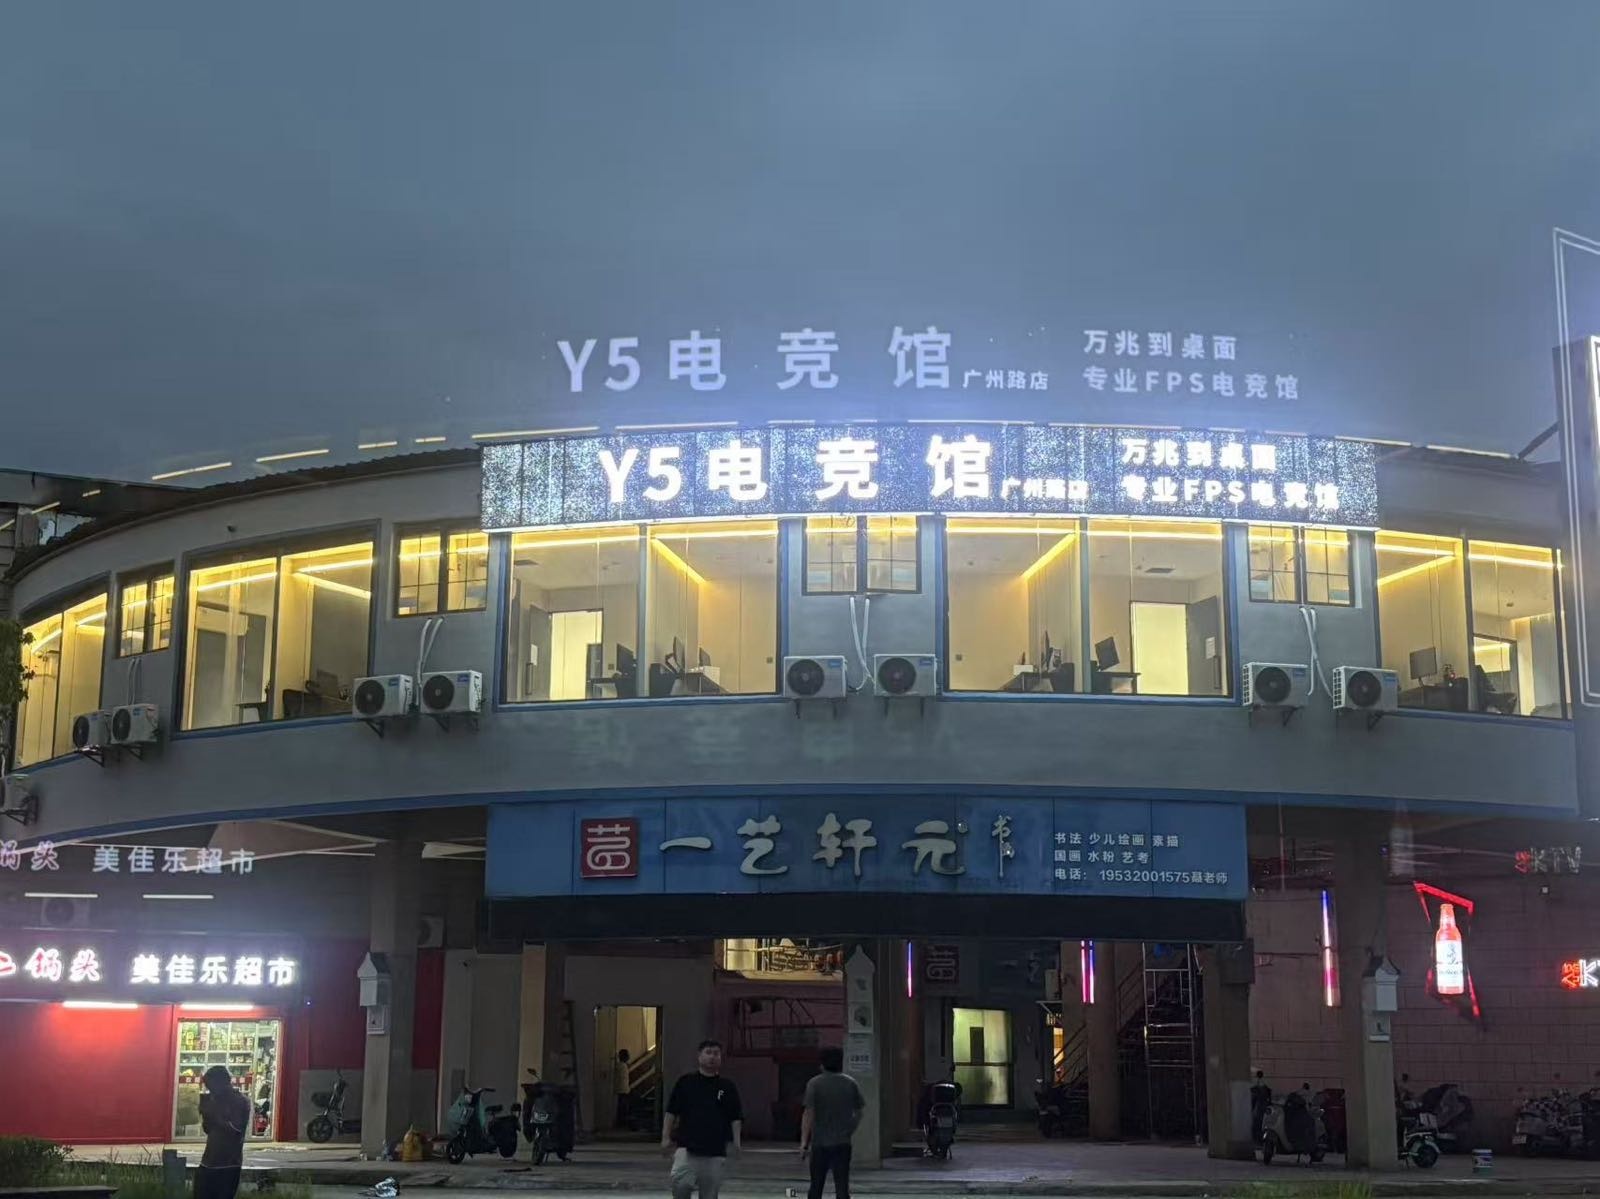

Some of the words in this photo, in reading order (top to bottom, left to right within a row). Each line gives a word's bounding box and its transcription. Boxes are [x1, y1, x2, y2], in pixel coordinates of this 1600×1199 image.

[1082, 329, 1238, 363] 万兆到桌面
[962, 369, 1050, 392] 广州路店
[1054, 832, 1081, 844] 书法
[1089, 833, 1145, 846] 少儿绘画
[1054, 850, 1081, 862] 国画
[1087, 850, 1114, 863] 水粉
[1122, 851, 1149, 864] 艺考
[130, 953, 297, 987] 美佳乐超市
